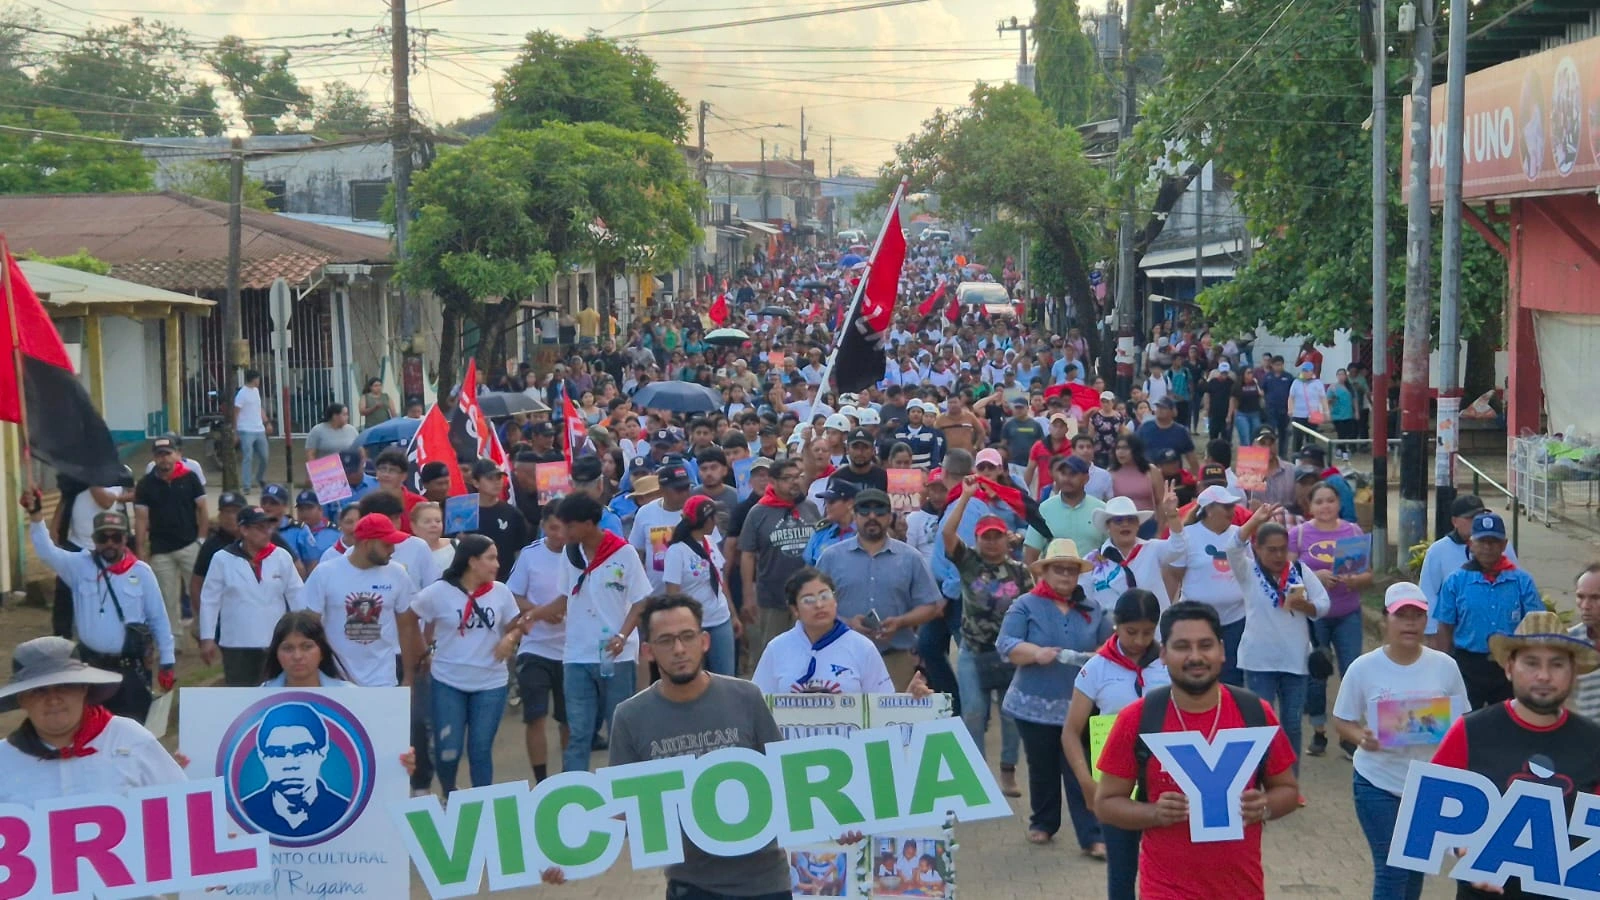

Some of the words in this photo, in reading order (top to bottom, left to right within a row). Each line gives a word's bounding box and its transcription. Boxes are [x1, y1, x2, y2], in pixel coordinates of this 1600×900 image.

[1474, 106, 1514, 163] UNO
[650, 728, 739, 756] AMERICAN
[1165, 740, 1257, 828] Y
[406, 731, 991, 886] VICTORIA
[271, 852, 303, 865] NTO
[308, 852, 388, 864] CULTURAL
[284, 869, 366, 900] Rugama
